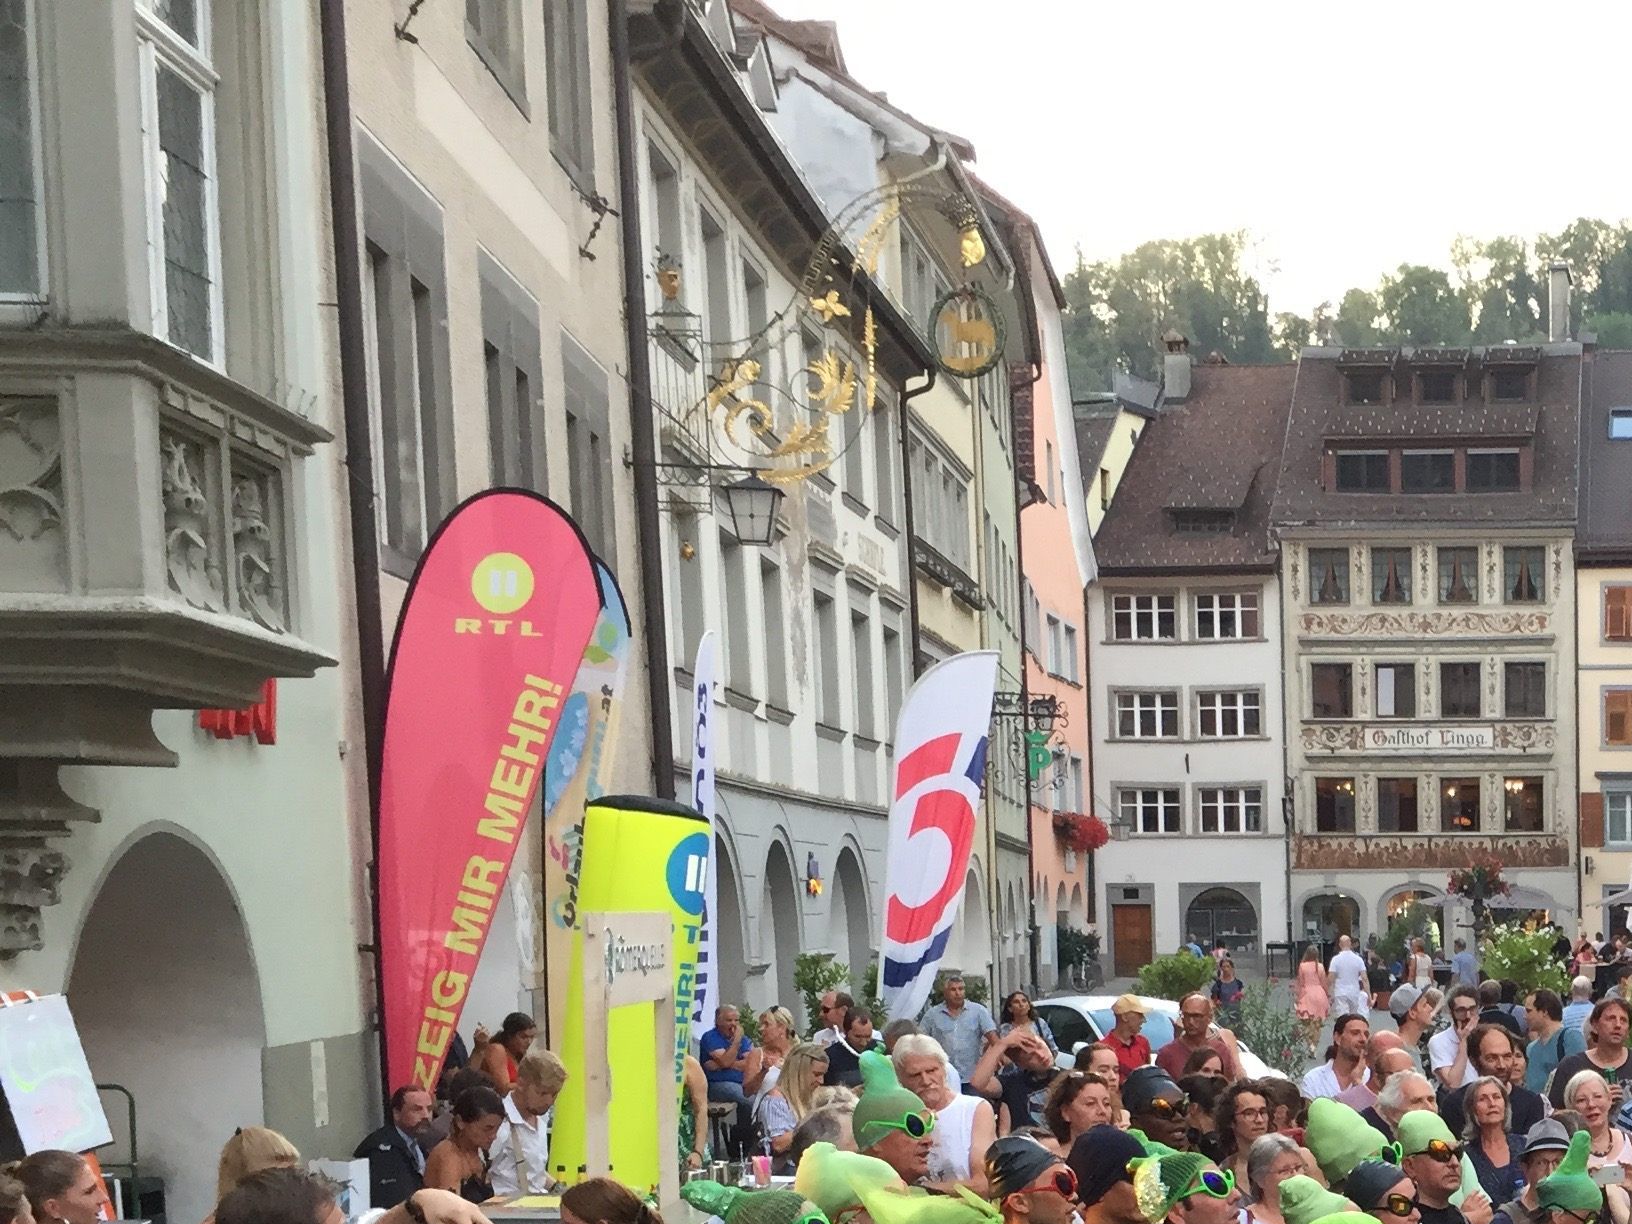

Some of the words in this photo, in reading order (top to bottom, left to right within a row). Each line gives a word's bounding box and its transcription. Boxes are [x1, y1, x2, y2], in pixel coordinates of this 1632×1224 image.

[454, 617, 544, 637] RTL
[1372, 729, 1432, 747] Gasthof
[411, 969, 468, 1093] ZEIG
[444, 855, 504, 956] MIR
[477, 673, 564, 844] MEHR!
